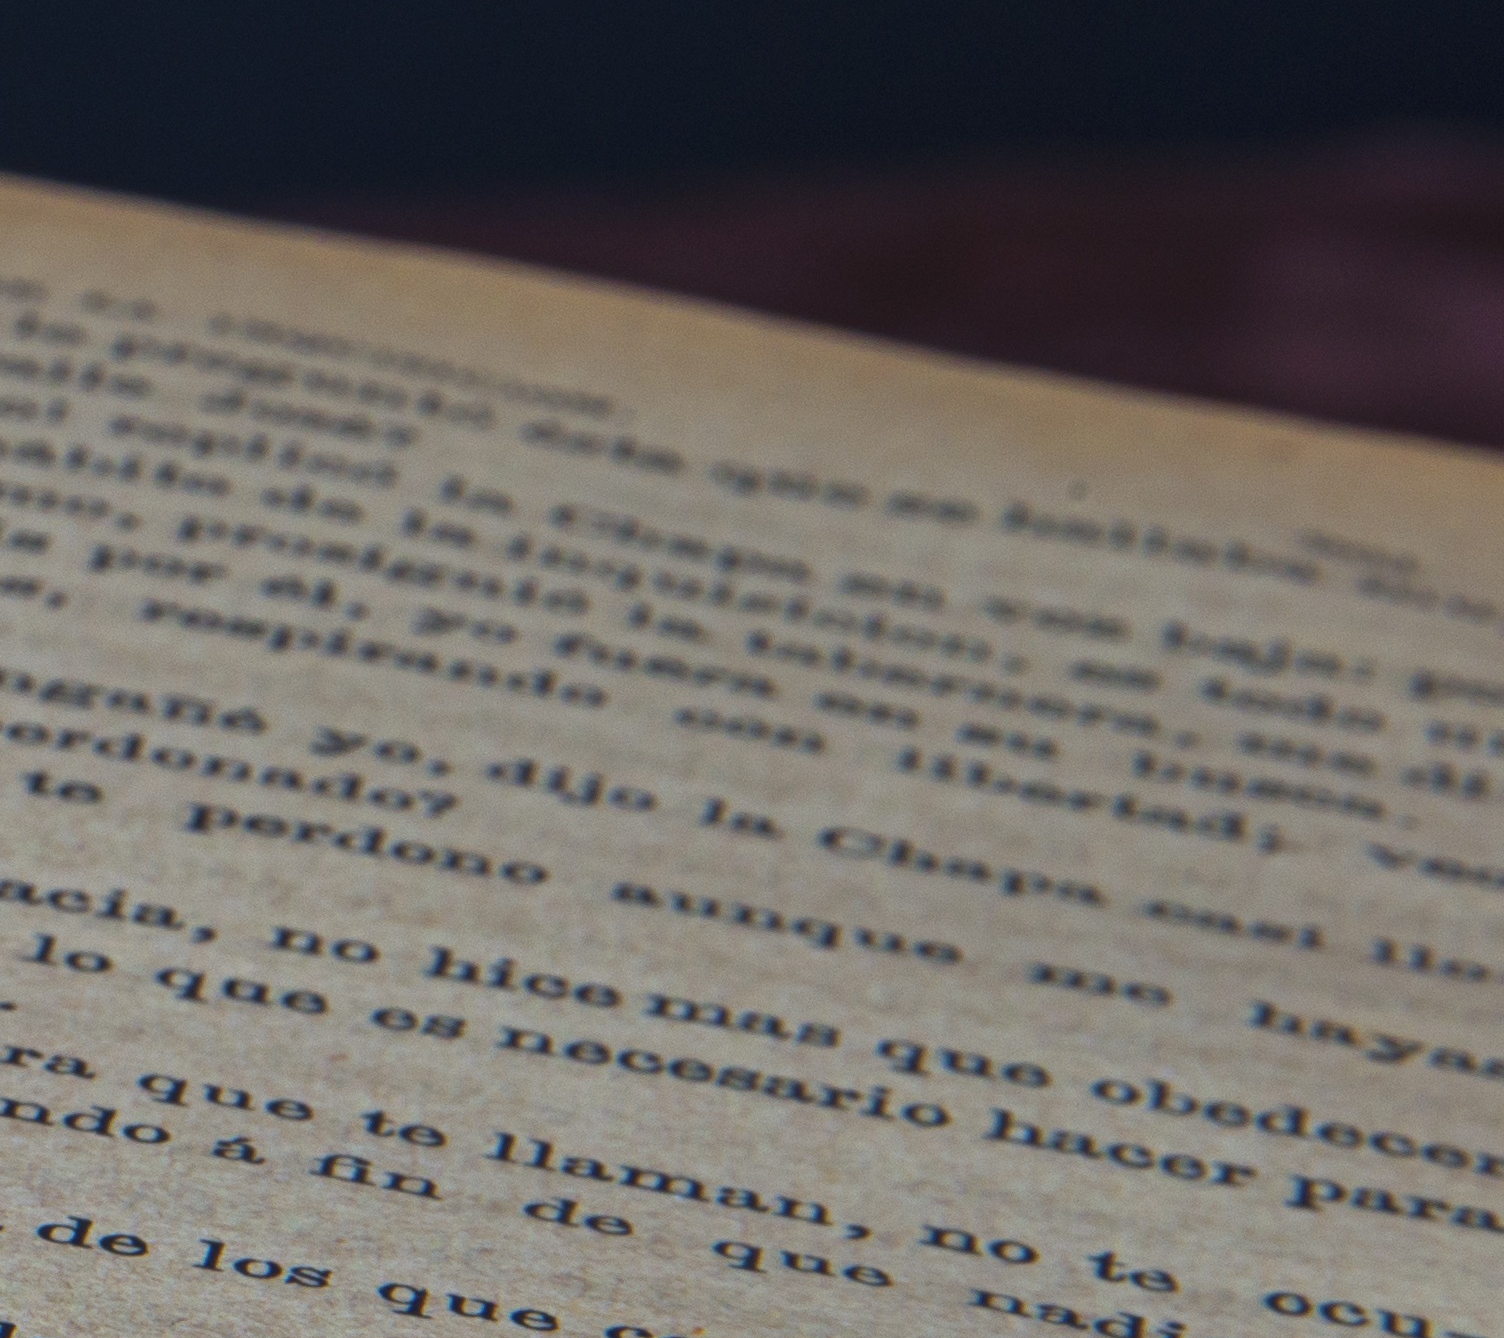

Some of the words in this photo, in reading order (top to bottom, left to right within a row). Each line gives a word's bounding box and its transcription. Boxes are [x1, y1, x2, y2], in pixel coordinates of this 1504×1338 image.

[25, 771, 102, 804] te
[185, 803, 548, 884] perdono
[612, 883, 961, 965] aunque
[1030, 964, 1170, 1006] me
[487, 759, 655, 811] dijo
[702, 799, 778, 839] la
[818, 828, 1103, 907] Chapa
[1143, 901, 1323, 951] casi
[28, 934, 112, 973] lo
[155, 968, 327, 1015] que
[370, 1008, 466, 1040] es
[498, 1027, 950, 1128] necesario
[986, 1109, 1255, 1187] hacer
[1286, 1176, 1504, 1234] para
[271, 927, 379, 964] no
[426, 947, 621, 1008] hice
[646, 994, 839, 1048] mas
[877, 1040, 1050, 1088] que
[36, 1216, 148, 1257] de
[195, 1239, 331, 1289] los
[377, 1282, 558, 1332] que
[138, 1074, 313, 1122] que
[363, 1110, 446, 1148] te
[490, 1132, 870, 1241] llaman,
[921, 1226, 1037, 1265] no
[1090, 1251, 1177, 1293] te
[211, 1136, 265, 1165] á
[311, 1154, 438, 1200] fin
[523, 1198, 632, 1236] de
[712, 1241, 891, 1288] que
